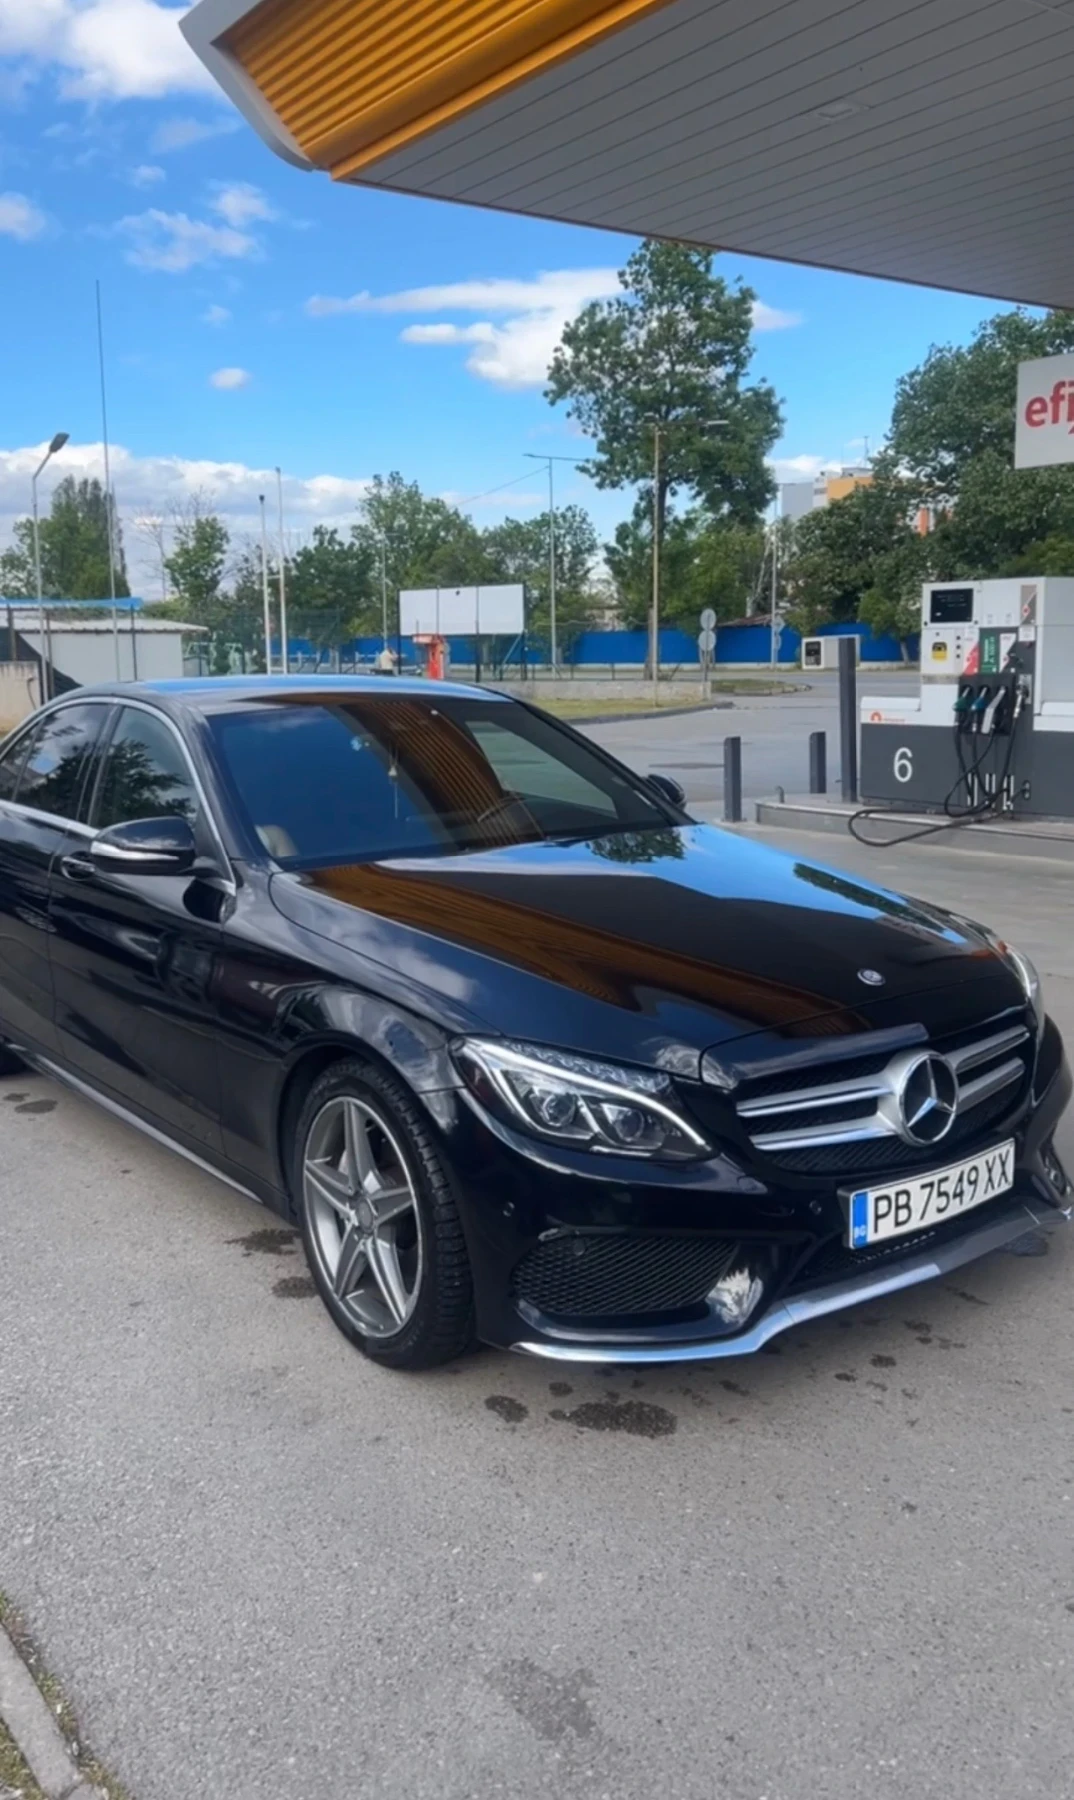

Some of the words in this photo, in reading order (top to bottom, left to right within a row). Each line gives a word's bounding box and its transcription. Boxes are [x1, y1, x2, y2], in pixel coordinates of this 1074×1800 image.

[894, 747, 913, 783] 6
[873, 1188, 912, 1234] PB
[920, 1165, 979, 1221] 7549
[984, 1148, 1011, 1194] XX
